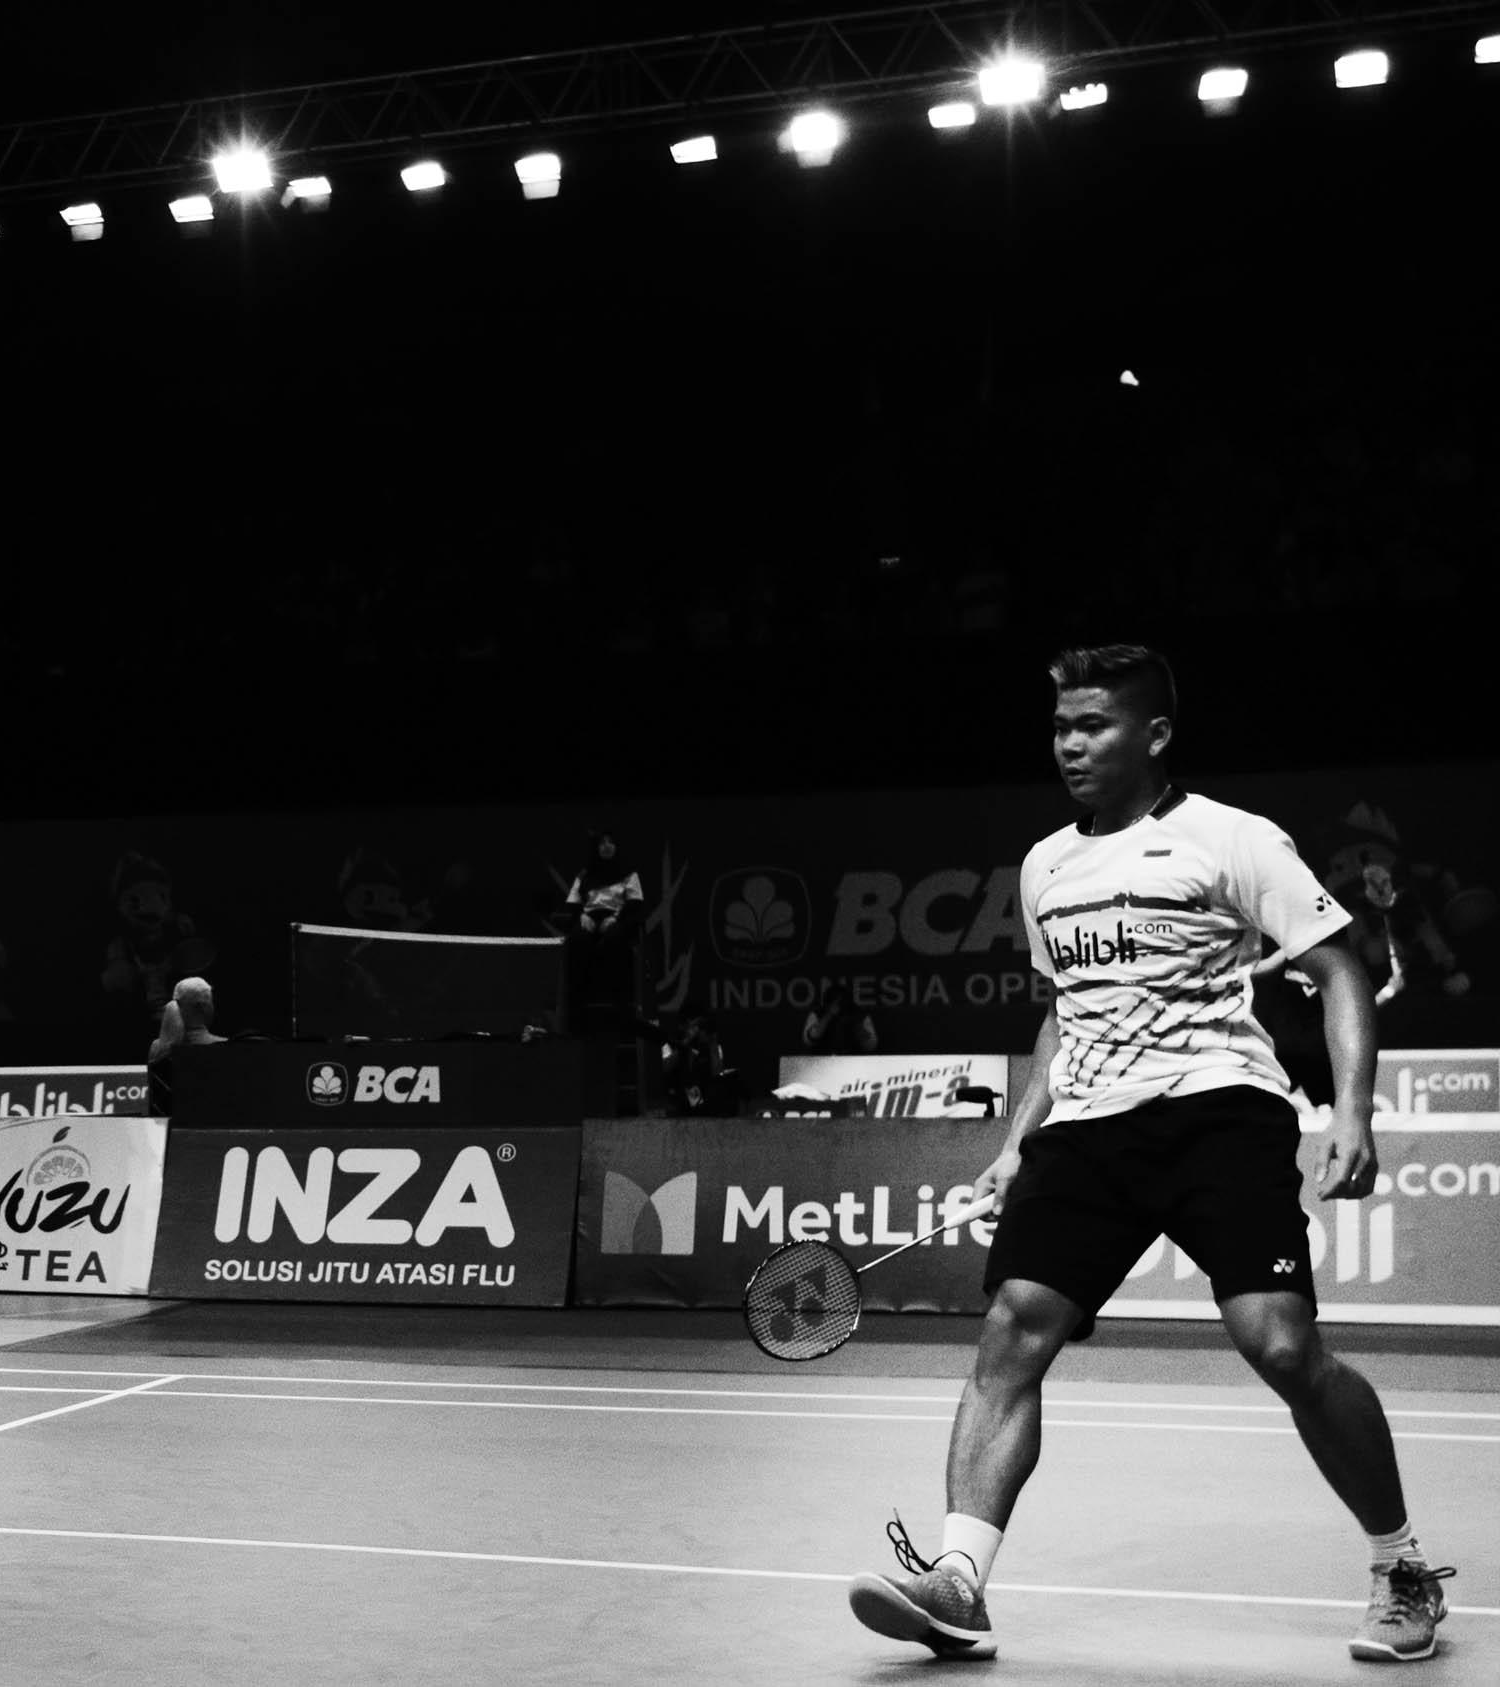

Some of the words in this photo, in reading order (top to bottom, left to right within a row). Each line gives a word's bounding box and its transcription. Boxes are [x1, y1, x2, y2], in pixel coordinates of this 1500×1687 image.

[826, 866, 1030, 957] BCA
[964, 972, 1057, 1004] OPE
[354, 1065, 441, 1103] BCA
[887, 1060, 972, 1086] mineral
[16, 1249, 107, 1283] TEA
[204, 1259, 301, 1283] SOLUSI
[308, 1260, 370, 1284] JITU
[375, 1261, 455, 1285] ATASI
[462, 1263, 516, 1287] FLU
